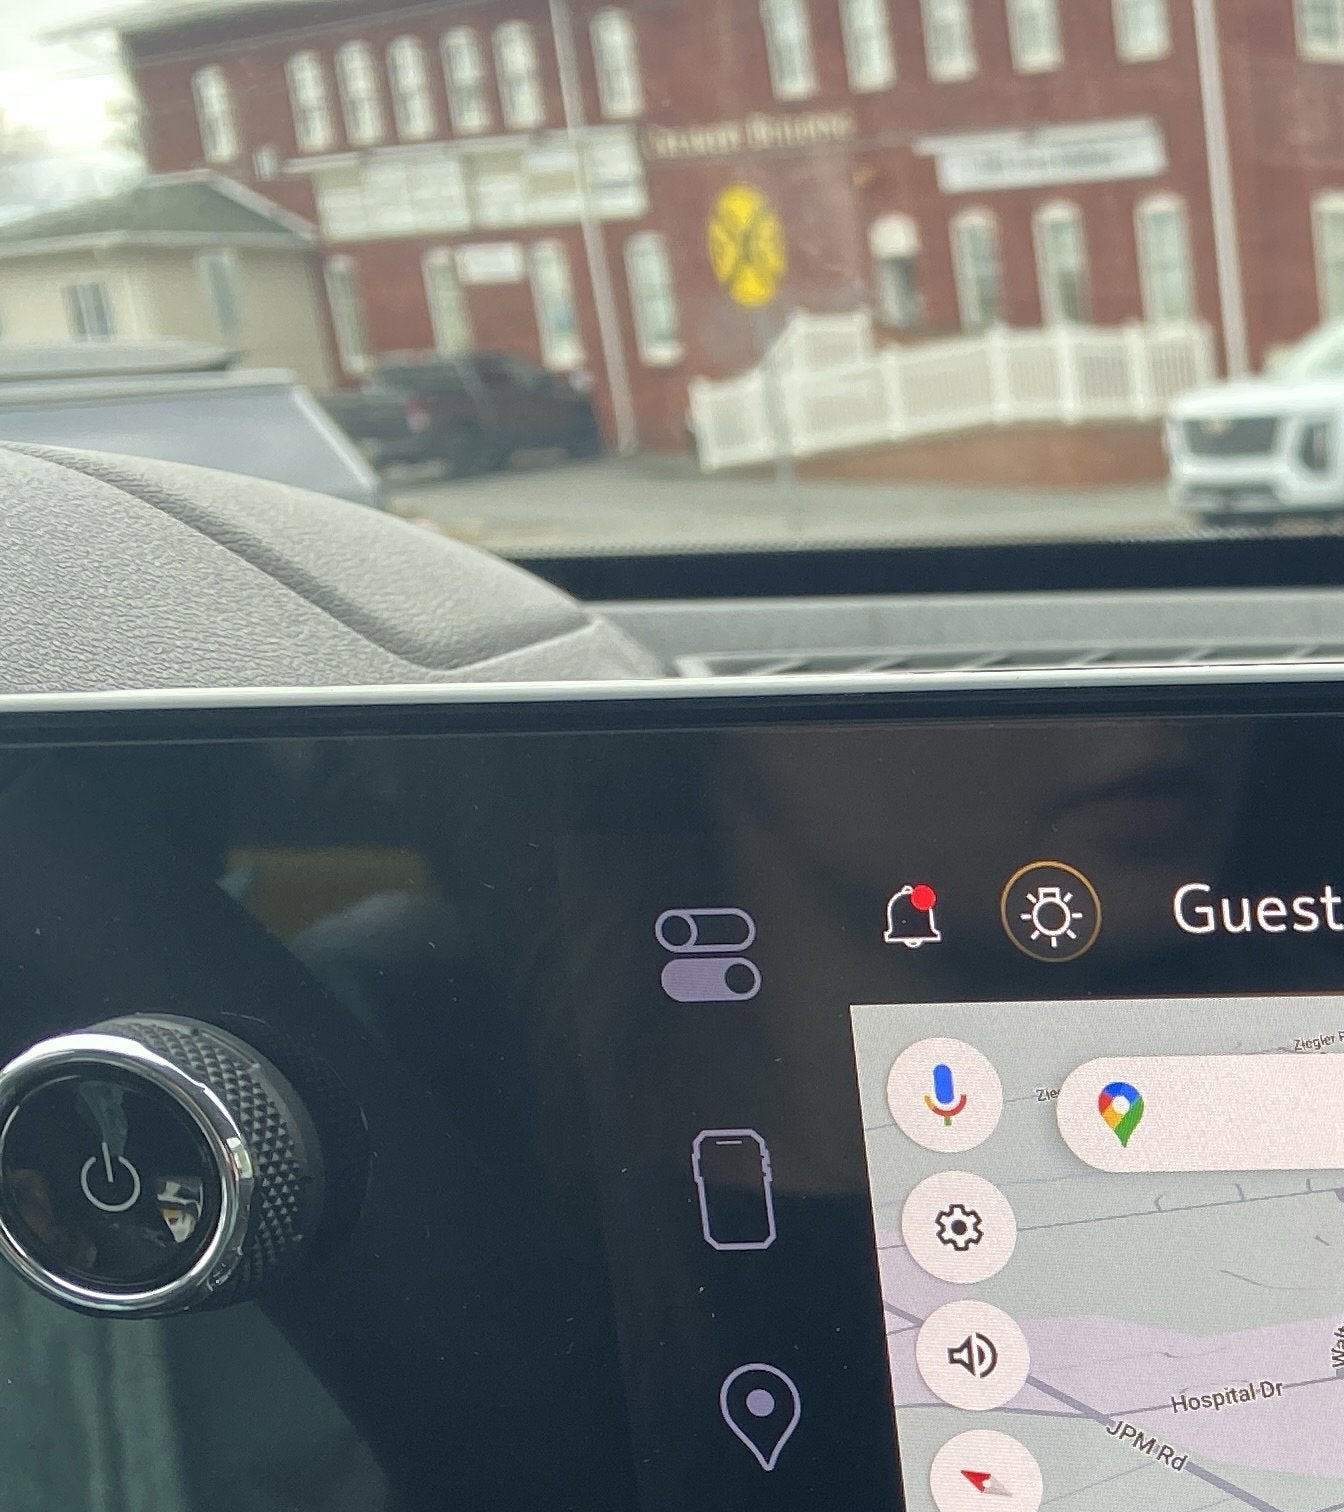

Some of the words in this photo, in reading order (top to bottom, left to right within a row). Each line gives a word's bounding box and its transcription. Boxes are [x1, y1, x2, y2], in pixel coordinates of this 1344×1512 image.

[1294, 1032, 1335, 1053] Ziegler
[1171, 1384, 1257, 1413] Hospital
[1260, 1380, 1284, 1398] Dr
[1107, 1419, 1157, 1457] JPM
[1157, 1443, 1188, 1472] Rd
